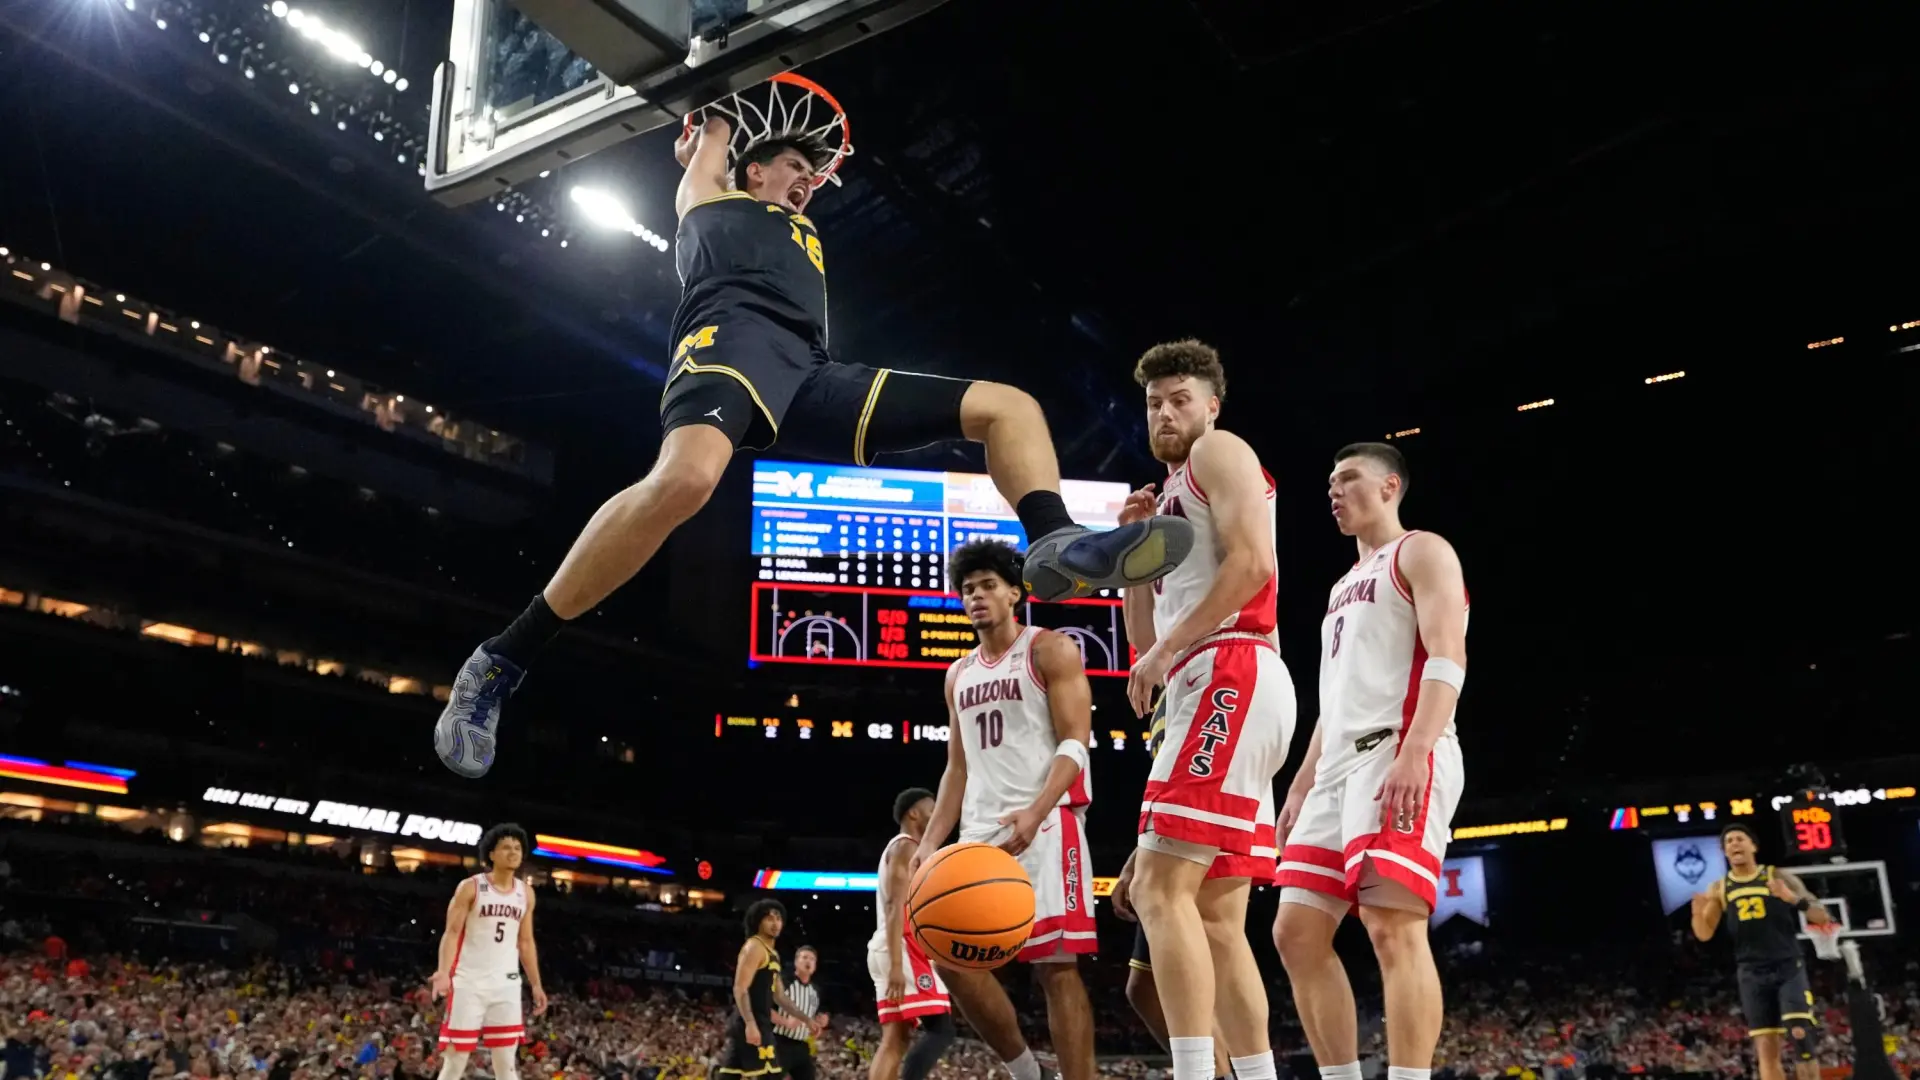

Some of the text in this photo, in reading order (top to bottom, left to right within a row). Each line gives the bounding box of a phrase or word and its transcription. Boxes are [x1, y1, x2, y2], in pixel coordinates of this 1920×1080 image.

[674, 325, 719, 364] M
[1331, 615, 1344, 659] 8
[959, 678, 1023, 711] ARIZONA
[765, 726, 811, 739] 2 2
[867, 723, 893, 739] 62
[976, 709, 1004, 750] 10
[1188, 688, 1239, 778] CATS
[310, 800, 400, 834] FINAL
[401, 814, 483, 846] FOUR
[1796, 824, 1832, 850] 30
[1067, 848, 1079, 912] CATS
[1736, 897, 1766, 921] 23
[494, 921, 507, 943] 5
